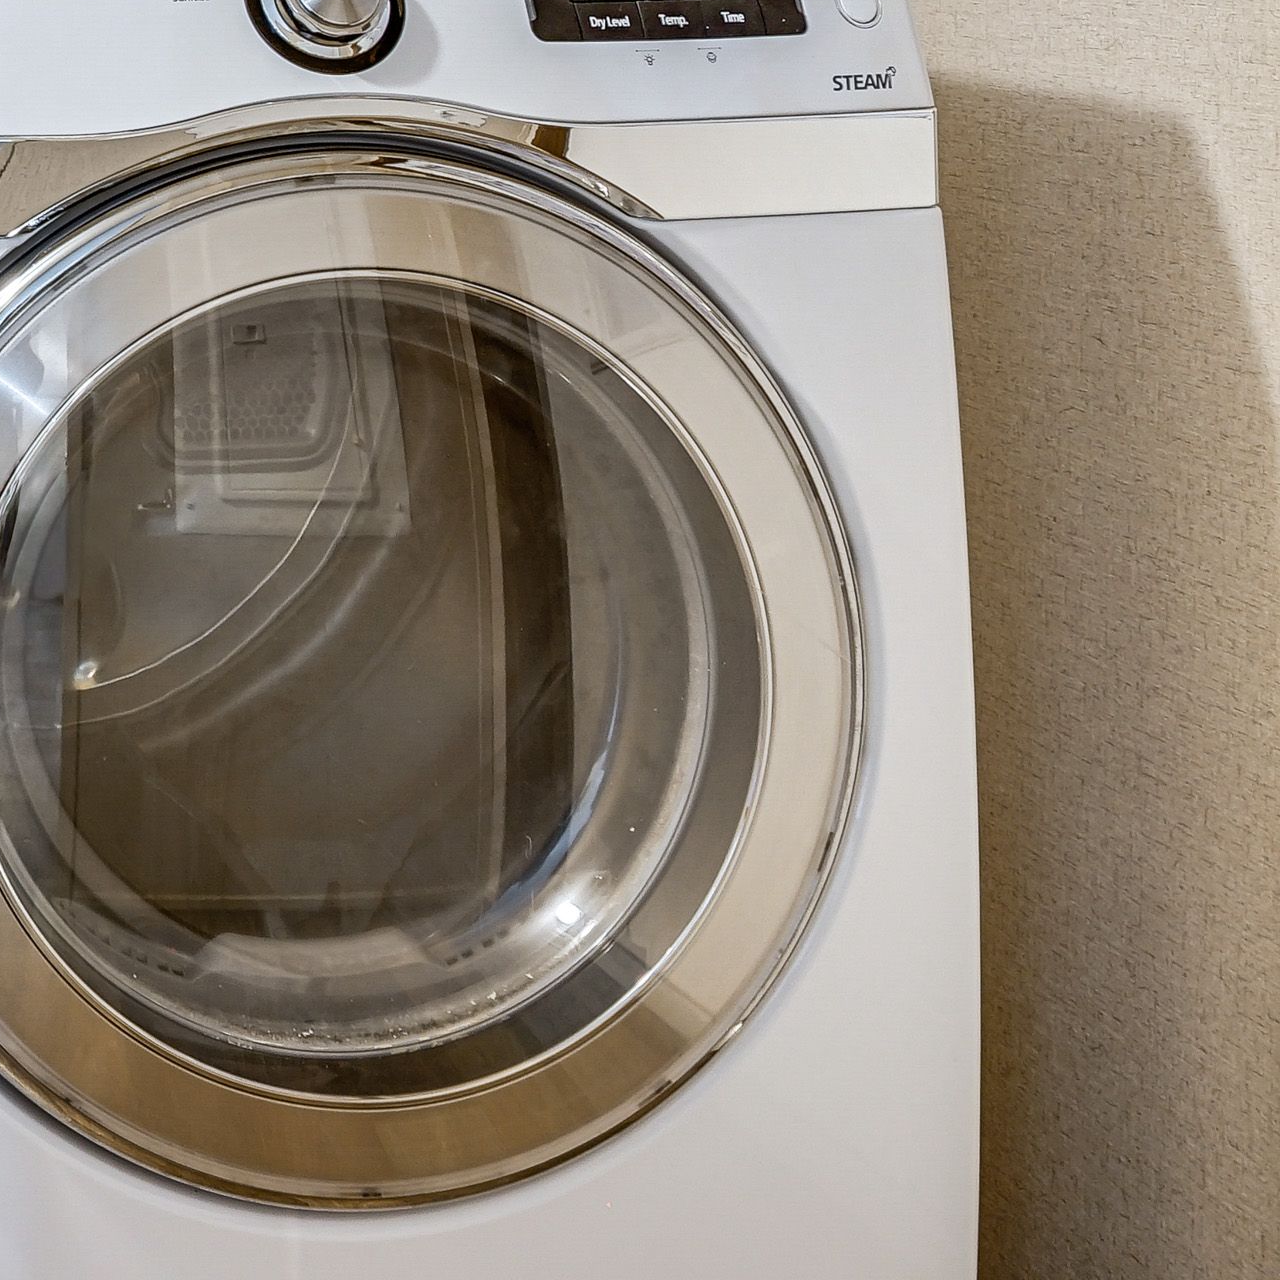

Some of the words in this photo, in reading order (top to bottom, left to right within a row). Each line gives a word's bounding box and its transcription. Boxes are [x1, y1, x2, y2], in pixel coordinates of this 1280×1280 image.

[589, 15, 607, 30] Dry
[607, 15, 631, 27] Level
[658, 13, 689, 27] Temp.
[720, 11, 746, 24] Time
[832, 73, 892, 91] STEAM
